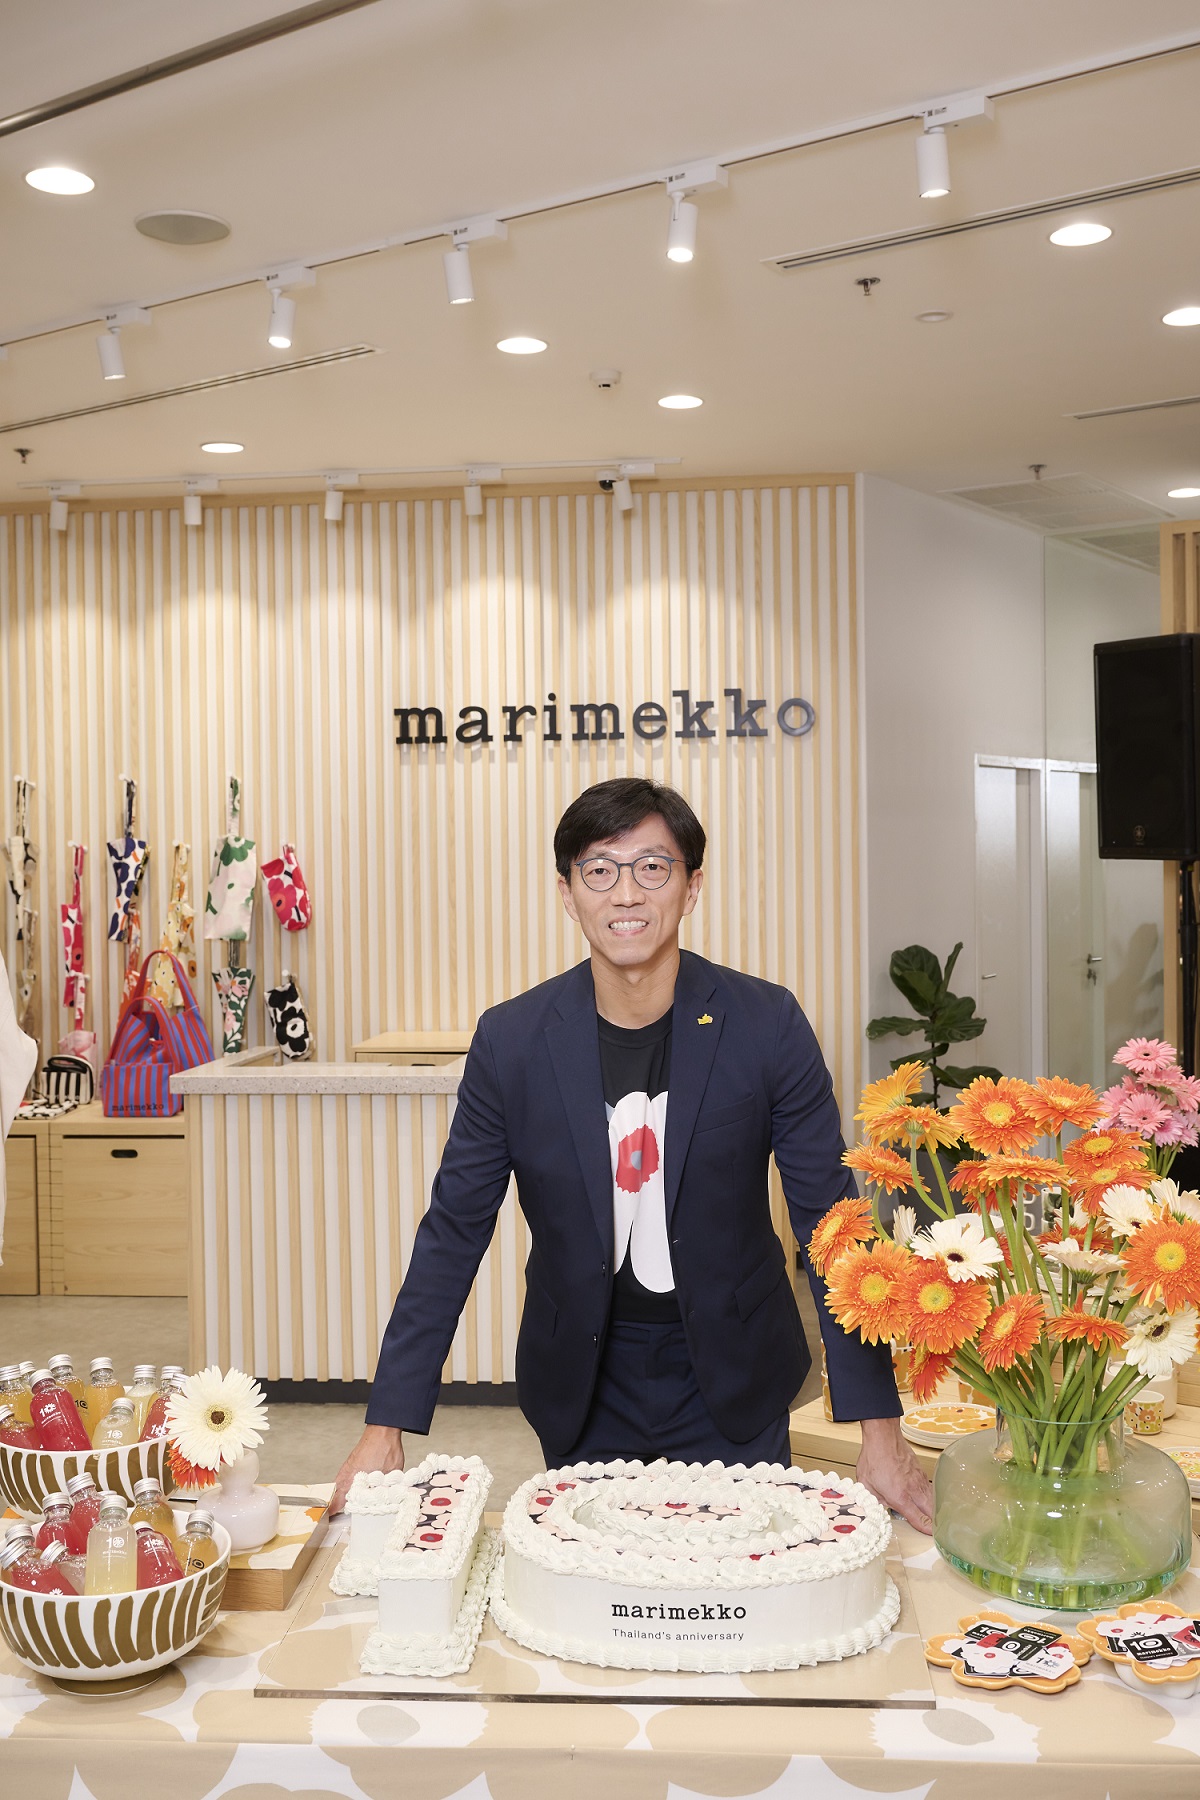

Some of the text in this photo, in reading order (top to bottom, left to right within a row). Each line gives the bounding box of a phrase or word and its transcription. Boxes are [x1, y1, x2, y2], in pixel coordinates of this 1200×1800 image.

[394, 688, 816, 744] marimekko
[111, 1102, 165, 1112] marimekko
[611, 1603, 747, 1620] marimekko
[612, 1628, 744, 1641] Thailand's anniversary
[1130, 1638, 1163, 1650] 10
